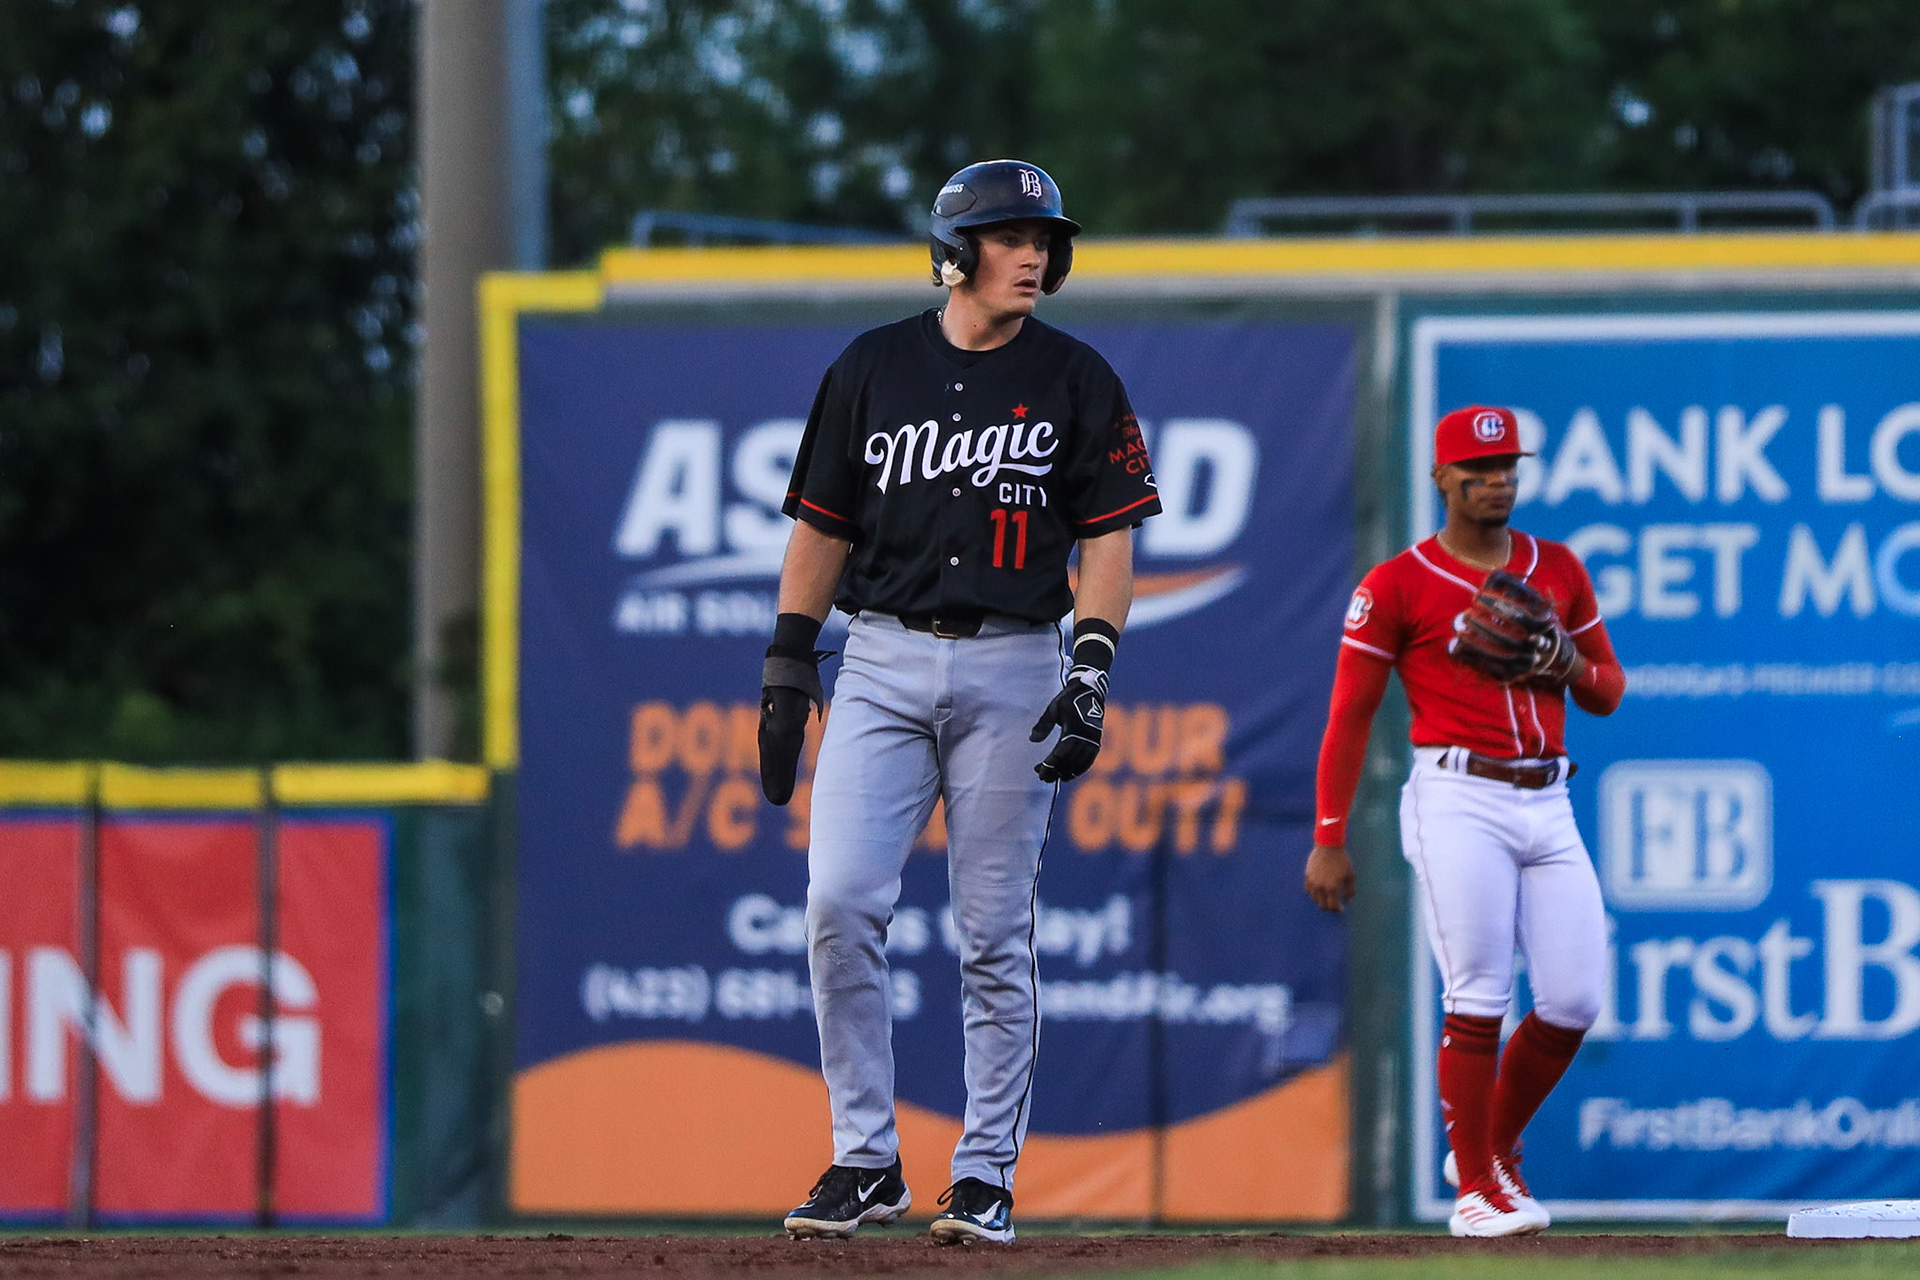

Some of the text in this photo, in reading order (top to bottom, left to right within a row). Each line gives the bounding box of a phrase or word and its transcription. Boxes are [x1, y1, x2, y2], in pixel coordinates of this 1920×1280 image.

[865, 404, 1060, 494] Magic
[1512, 404, 1790, 504] BANK
[991, 508, 1028, 569] 11
[1562, 523, 1759, 619] GET
[615, 777, 758, 851] A/C
